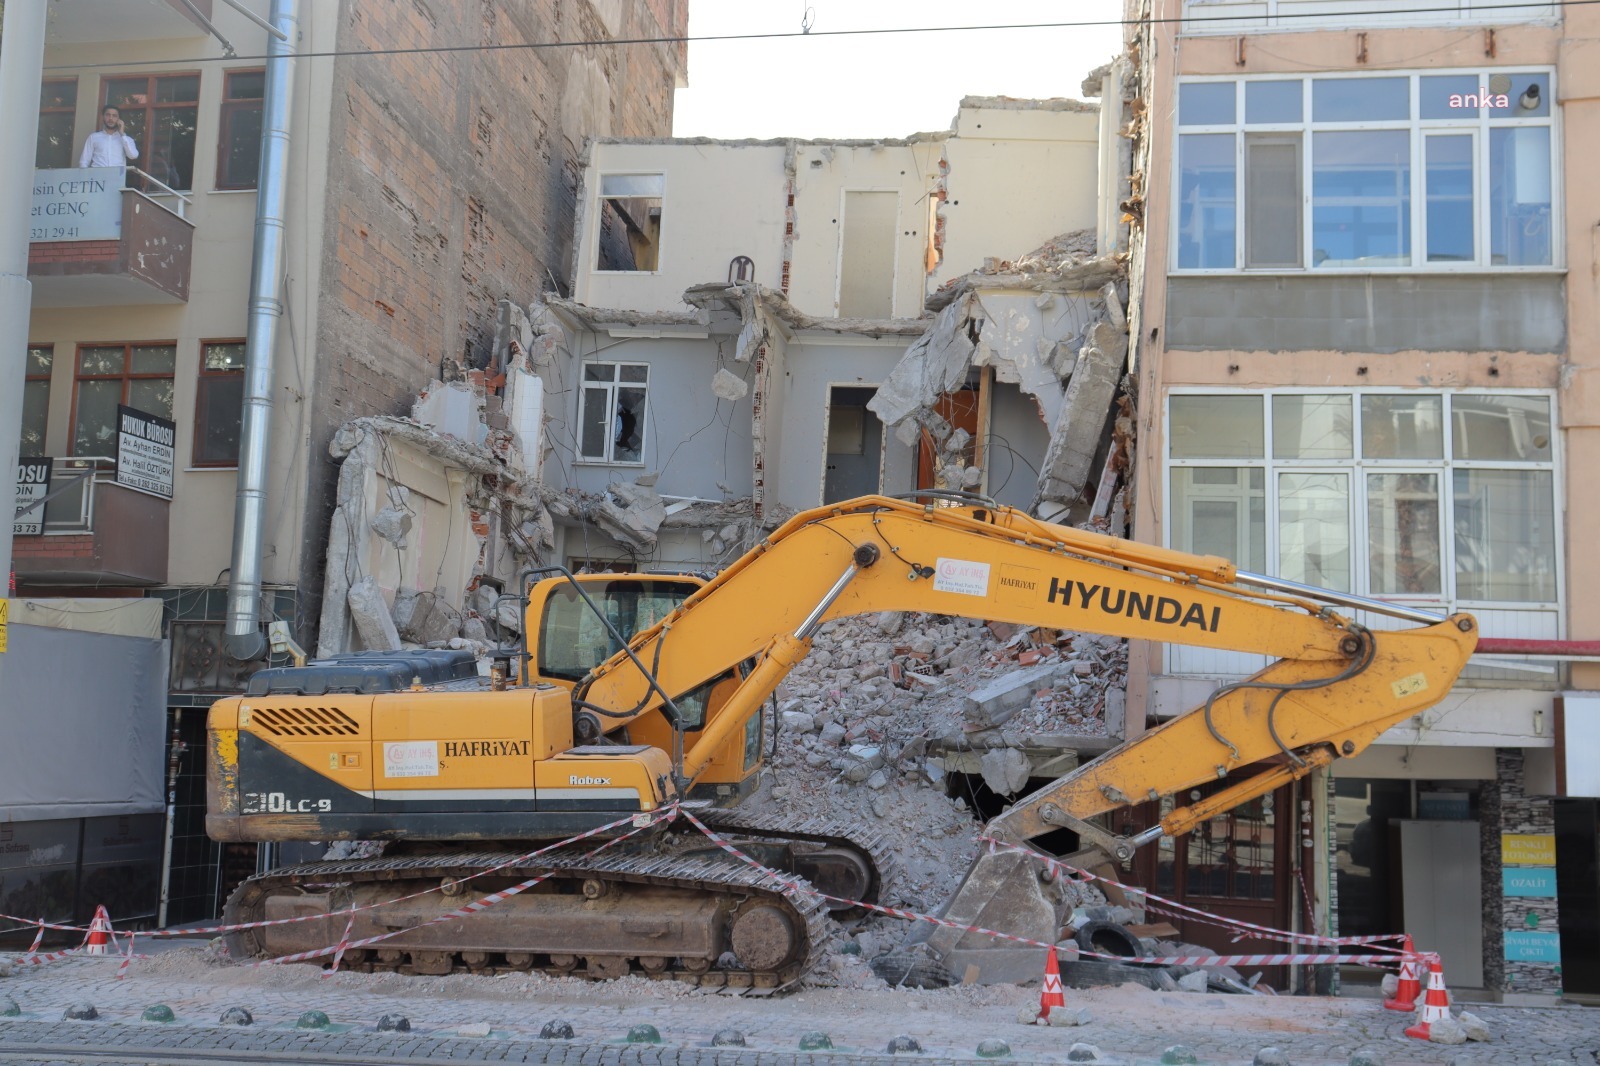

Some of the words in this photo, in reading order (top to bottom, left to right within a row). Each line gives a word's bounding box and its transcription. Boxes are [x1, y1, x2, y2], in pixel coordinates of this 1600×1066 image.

[58, 178, 106, 196] ÇETİN
[46, 202, 89, 217] GENÇ
[30, 228, 48, 239] 321
[52, 227, 65, 238] 29
[67, 227, 79, 237] 41
[122, 414, 146, 437] HUKUK
[146, 420, 173, 446] BÜROSU
[133, 440, 151, 453] Ayhan
[153, 445, 171, 458] ERDİN
[133, 460, 145, 471] Halil
[146, 461, 171, 478] ÖZTÜRK
[25, 525, 37, 533] 73
[1047, 577, 1221, 633] HYUNDAI
[569, 775, 612, 785] Robex
[1509, 838, 1546, 849] RENKLİ
[1511, 877, 1546, 888] OZALİT
[1520, 947, 1543, 957] ÇIKTI
